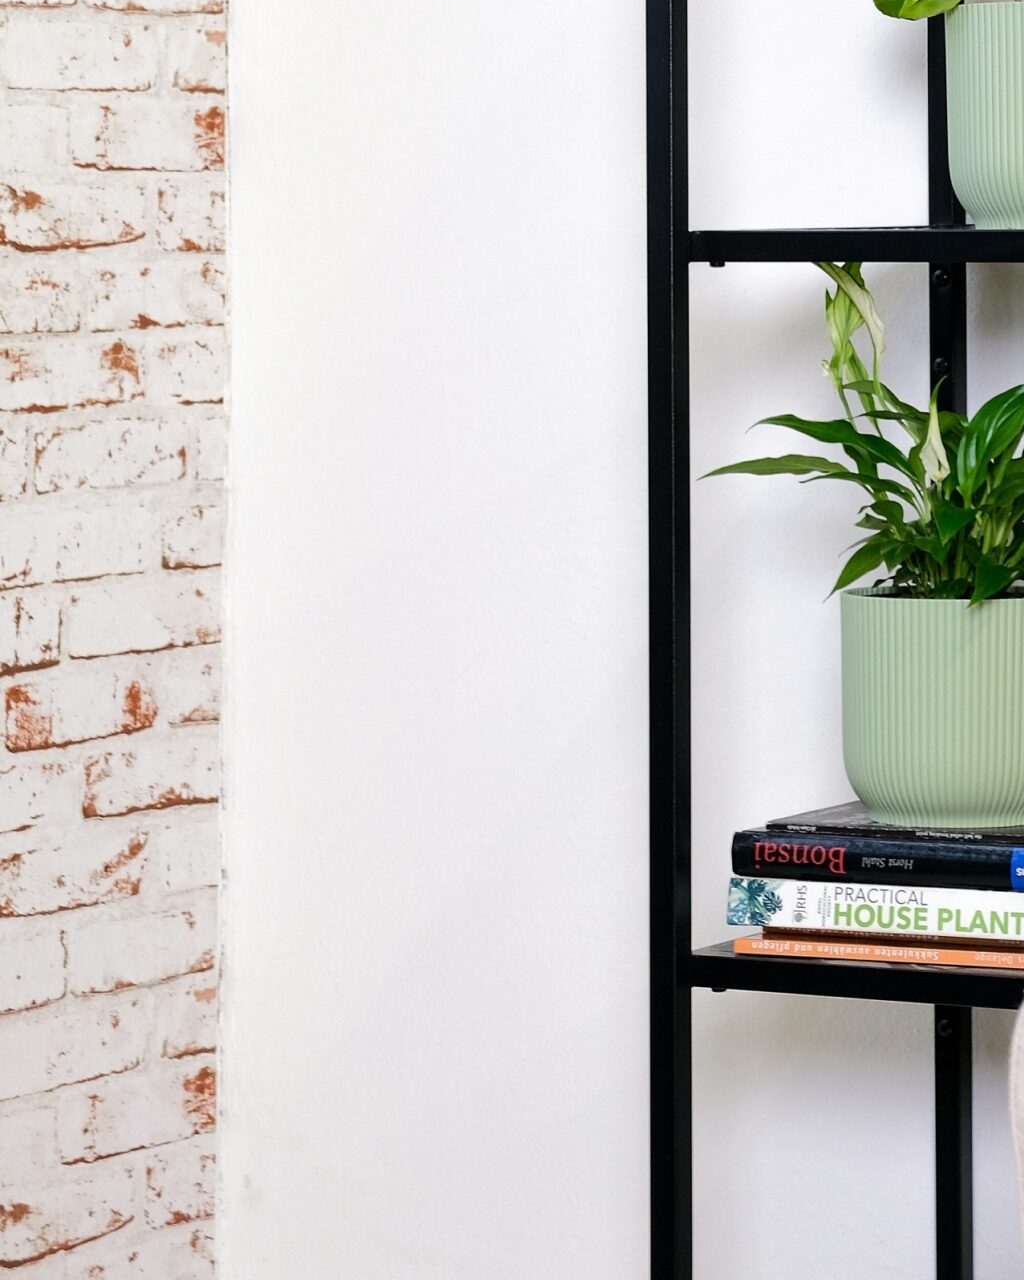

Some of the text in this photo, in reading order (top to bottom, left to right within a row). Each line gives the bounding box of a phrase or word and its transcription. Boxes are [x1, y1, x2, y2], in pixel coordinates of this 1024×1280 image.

[753, 841, 847, 874] Bonsai
[861, 856, 914, 870] Horst Stahl
[797, 885, 808, 909] RHS
[834, 886, 929, 906] PRACTICAL
[833, 903, 928, 931] HOUSE
[751, 940, 939, 960] Sukkulenten auswählen und pflegen
[975, 953, 1014, 964] Delange
